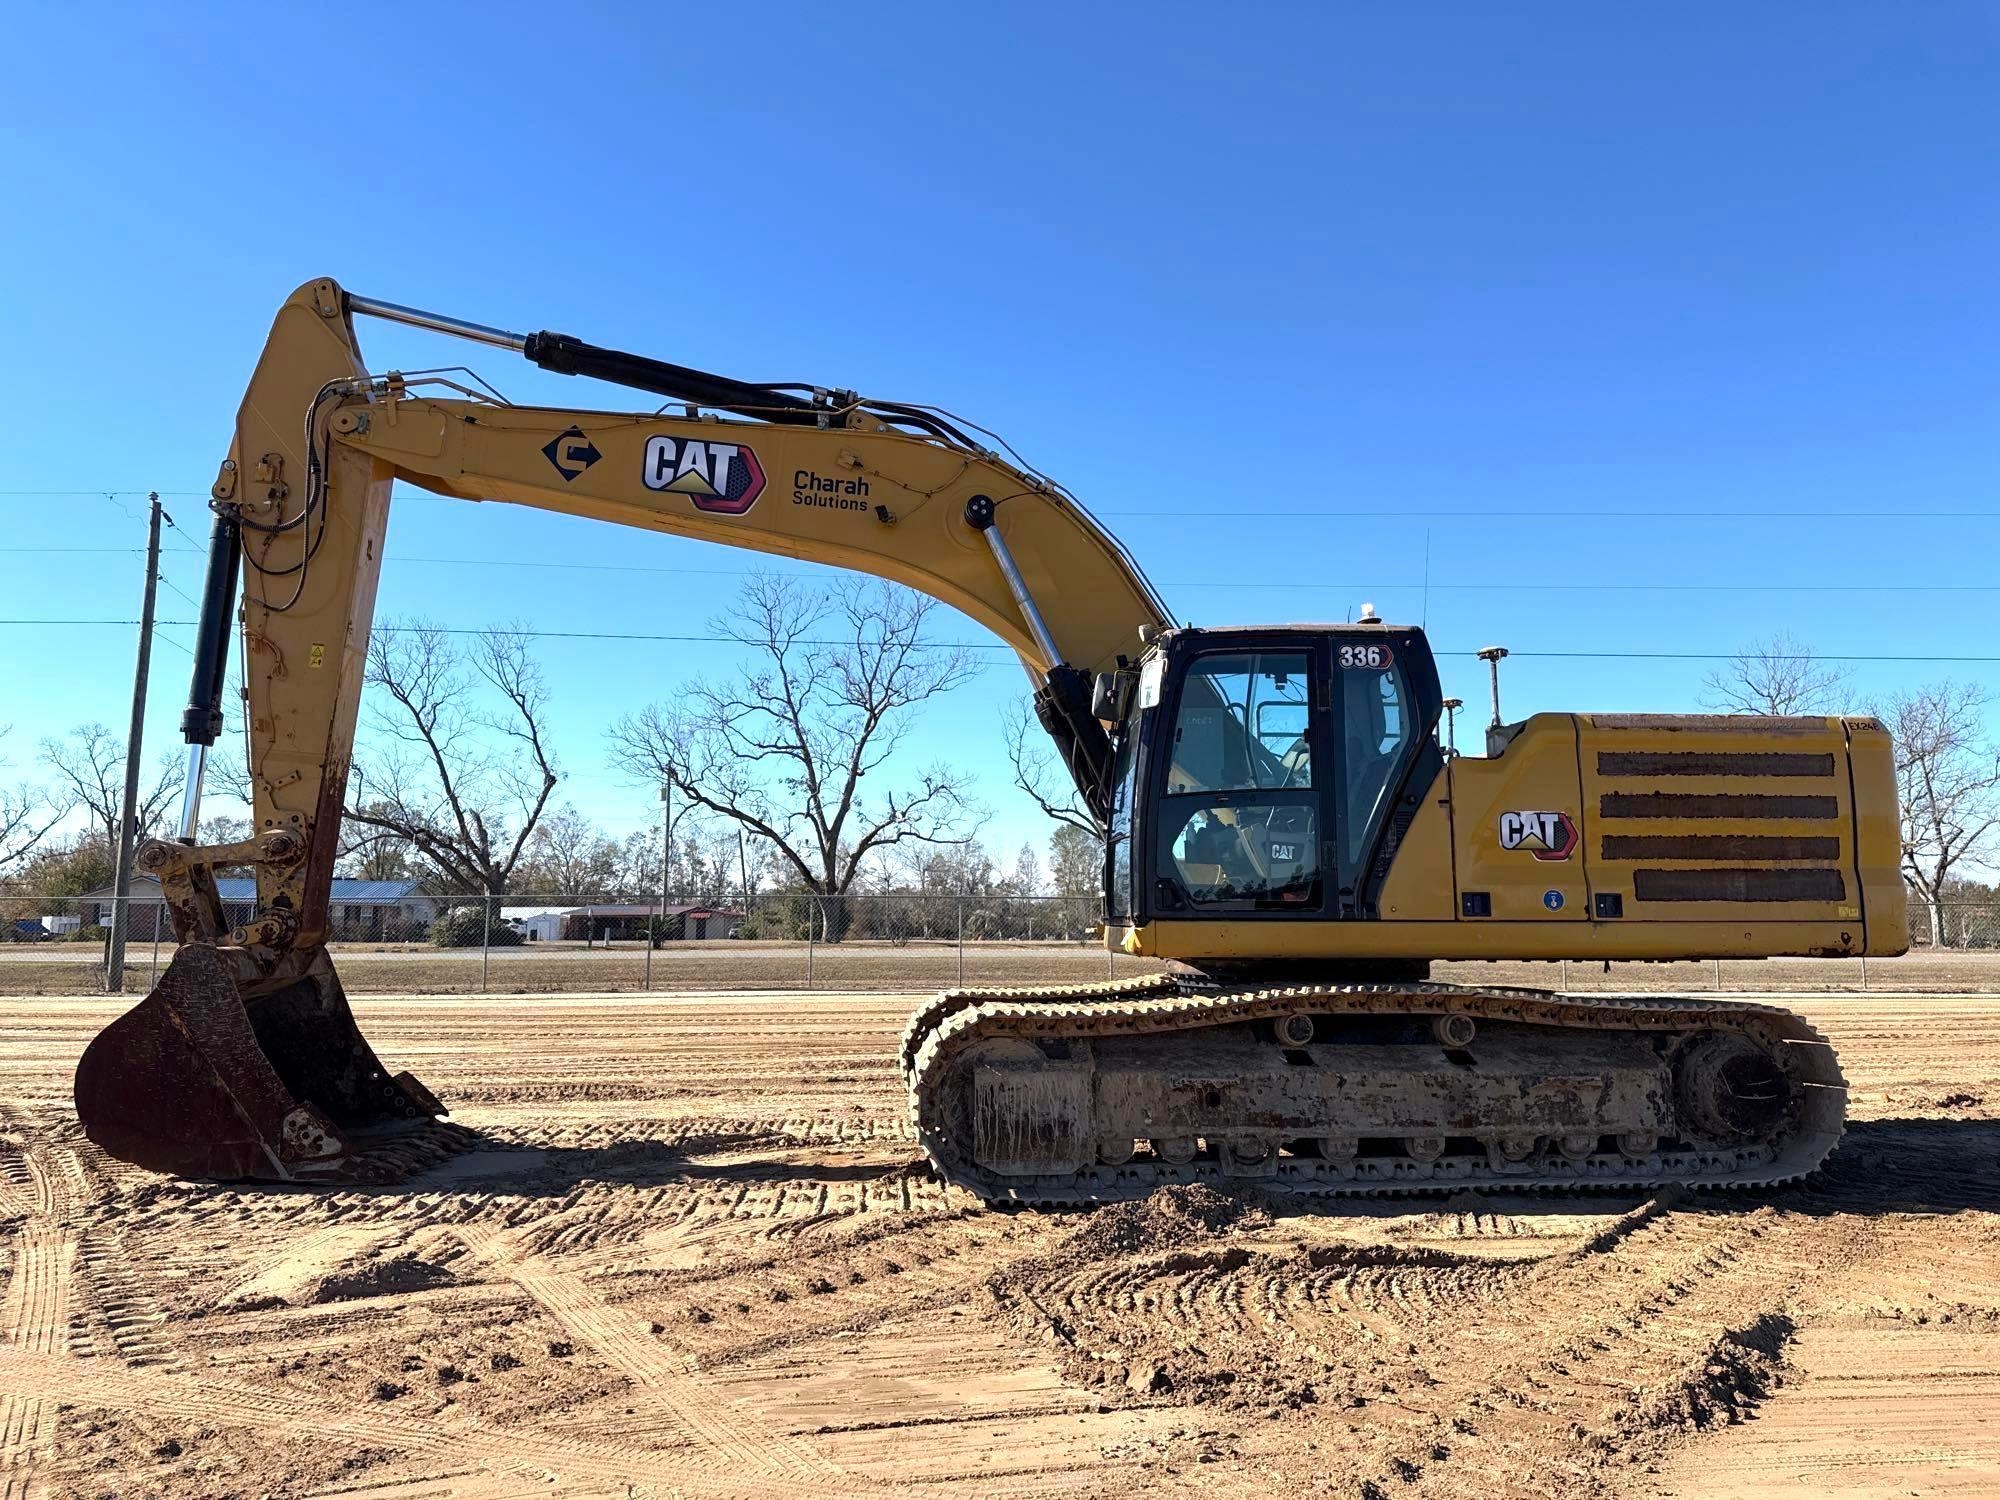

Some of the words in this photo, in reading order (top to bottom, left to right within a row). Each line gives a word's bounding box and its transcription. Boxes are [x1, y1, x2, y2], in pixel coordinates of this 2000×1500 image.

[644, 436, 738, 496] CAT
[794, 470, 869, 497] Charah
[792, 490, 868, 511] Solutions
[1340, 646, 1380, 667] 336
[1501, 812, 1559, 849] CAT
[1271, 844, 1296, 860] CAT
